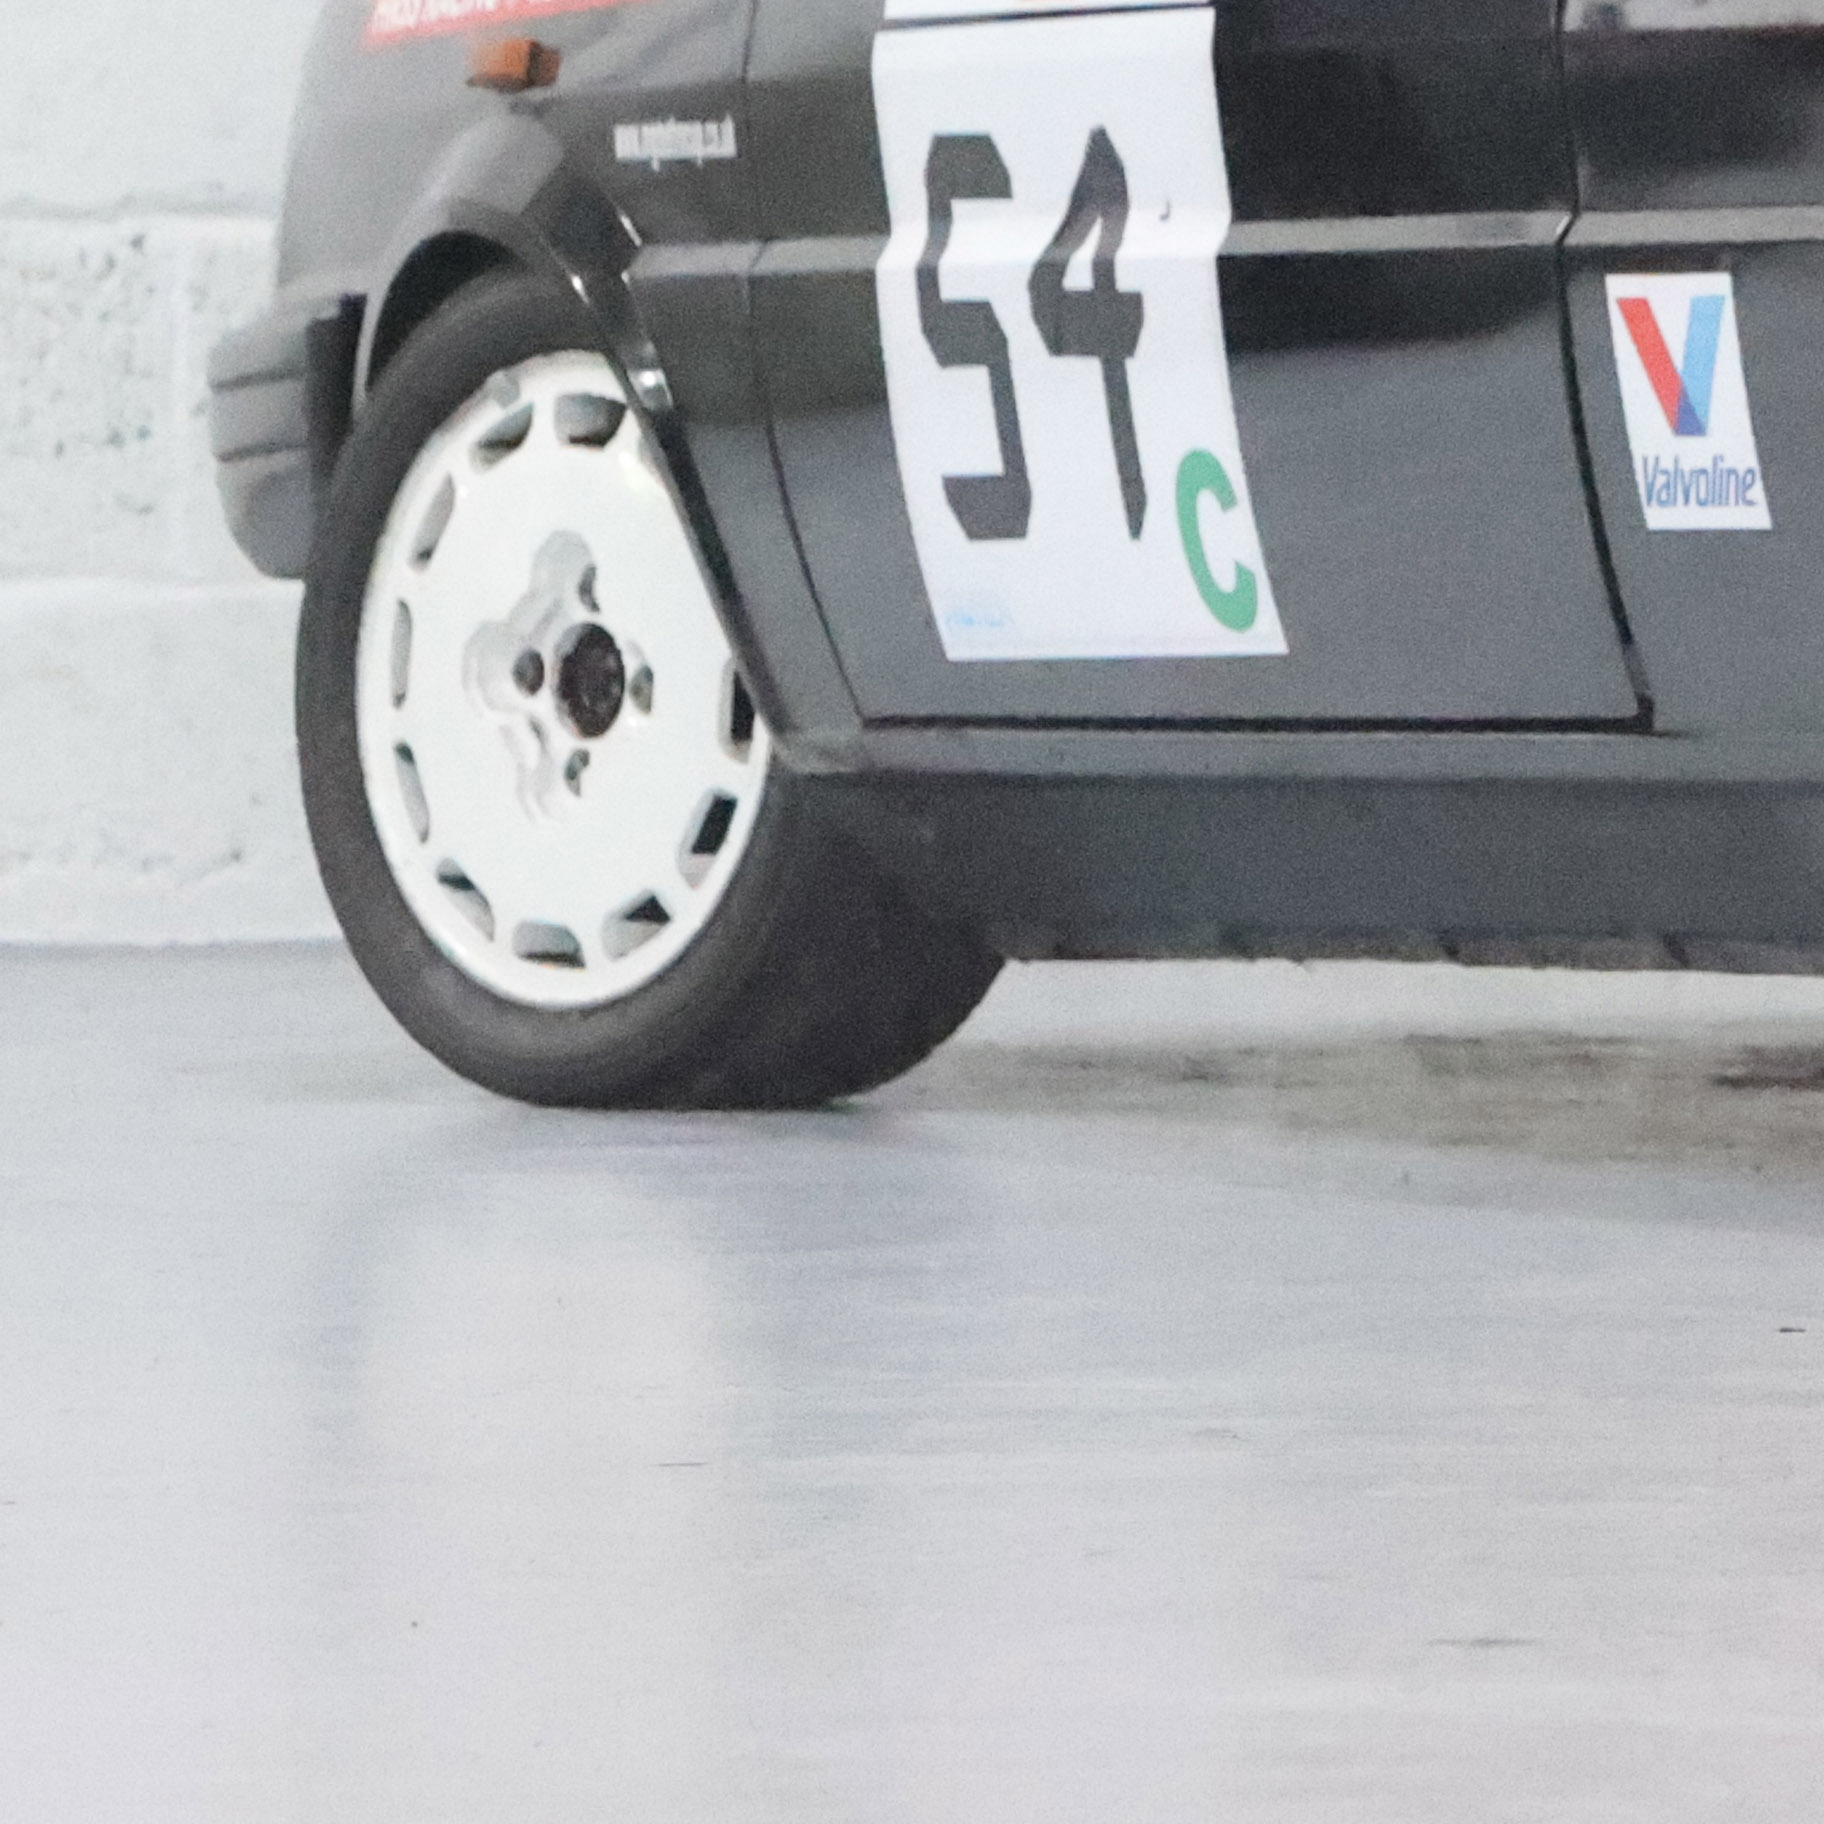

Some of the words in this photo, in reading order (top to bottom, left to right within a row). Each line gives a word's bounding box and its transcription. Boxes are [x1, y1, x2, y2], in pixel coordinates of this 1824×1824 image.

[917, 125, 1149, 543] 54
[1175, 448, 1258, 633] C
[1642, 454, 1759, 509] Valvoline
